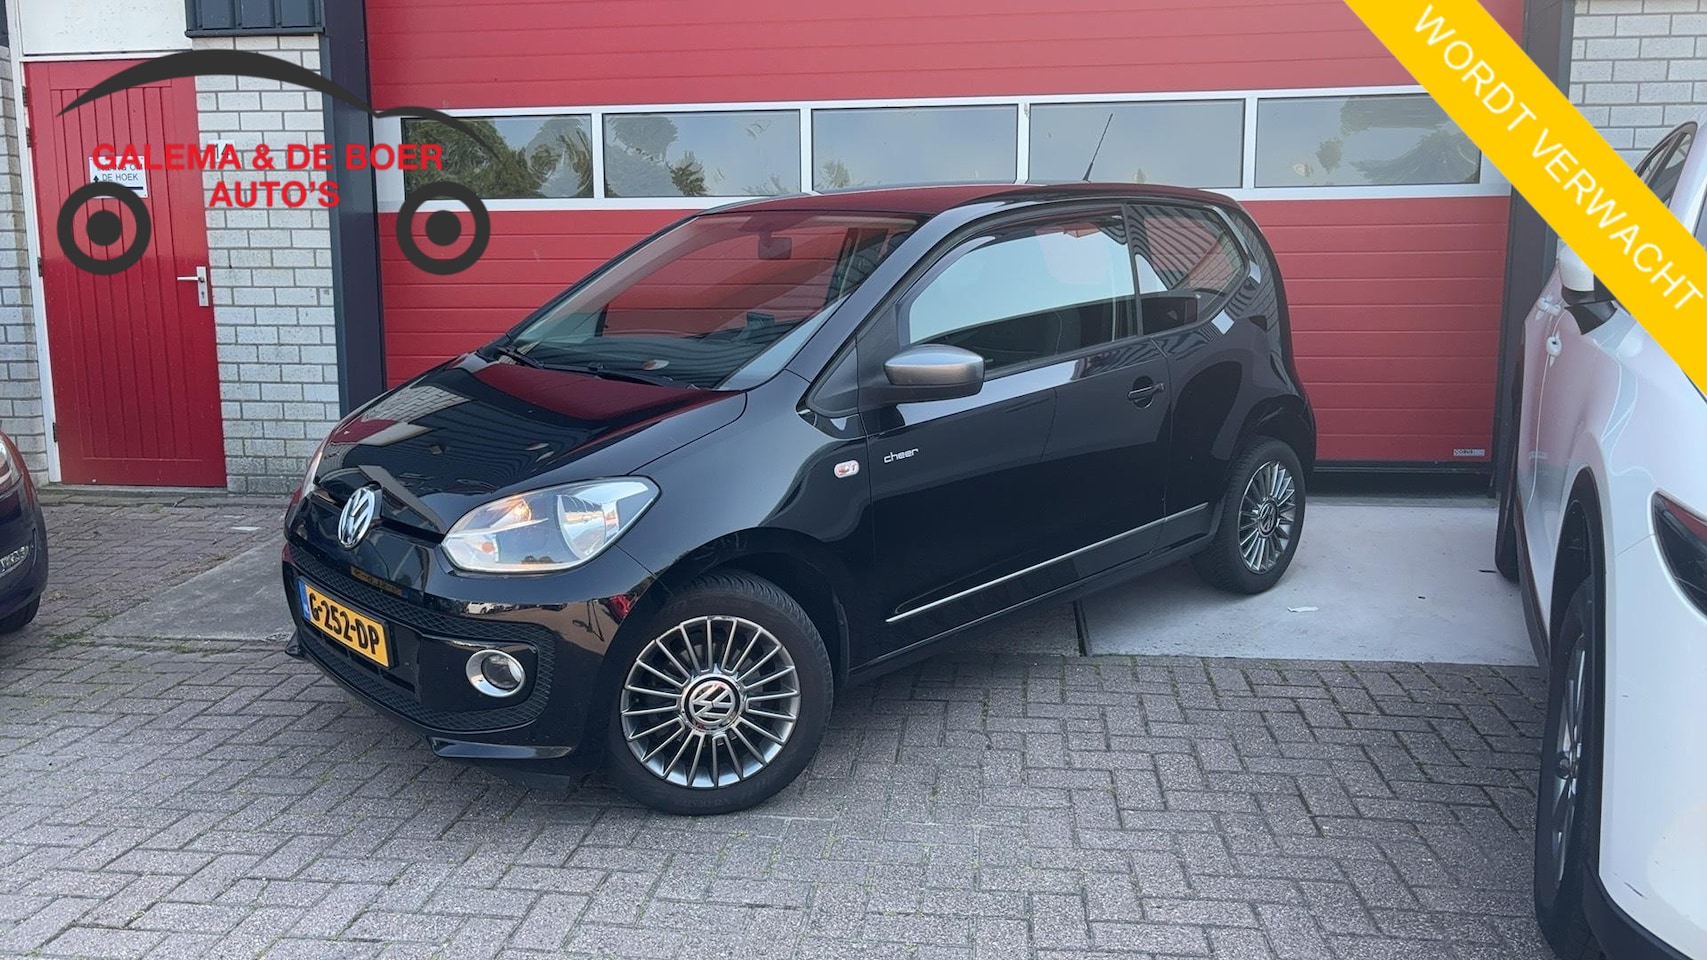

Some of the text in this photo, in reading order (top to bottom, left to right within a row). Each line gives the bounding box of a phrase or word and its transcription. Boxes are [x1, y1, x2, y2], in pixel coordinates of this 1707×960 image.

[102, 173, 138, 182] DE HOEK
[883, 447, 919, 464] cheer
[309, 592, 380, 655] G-252-DP
